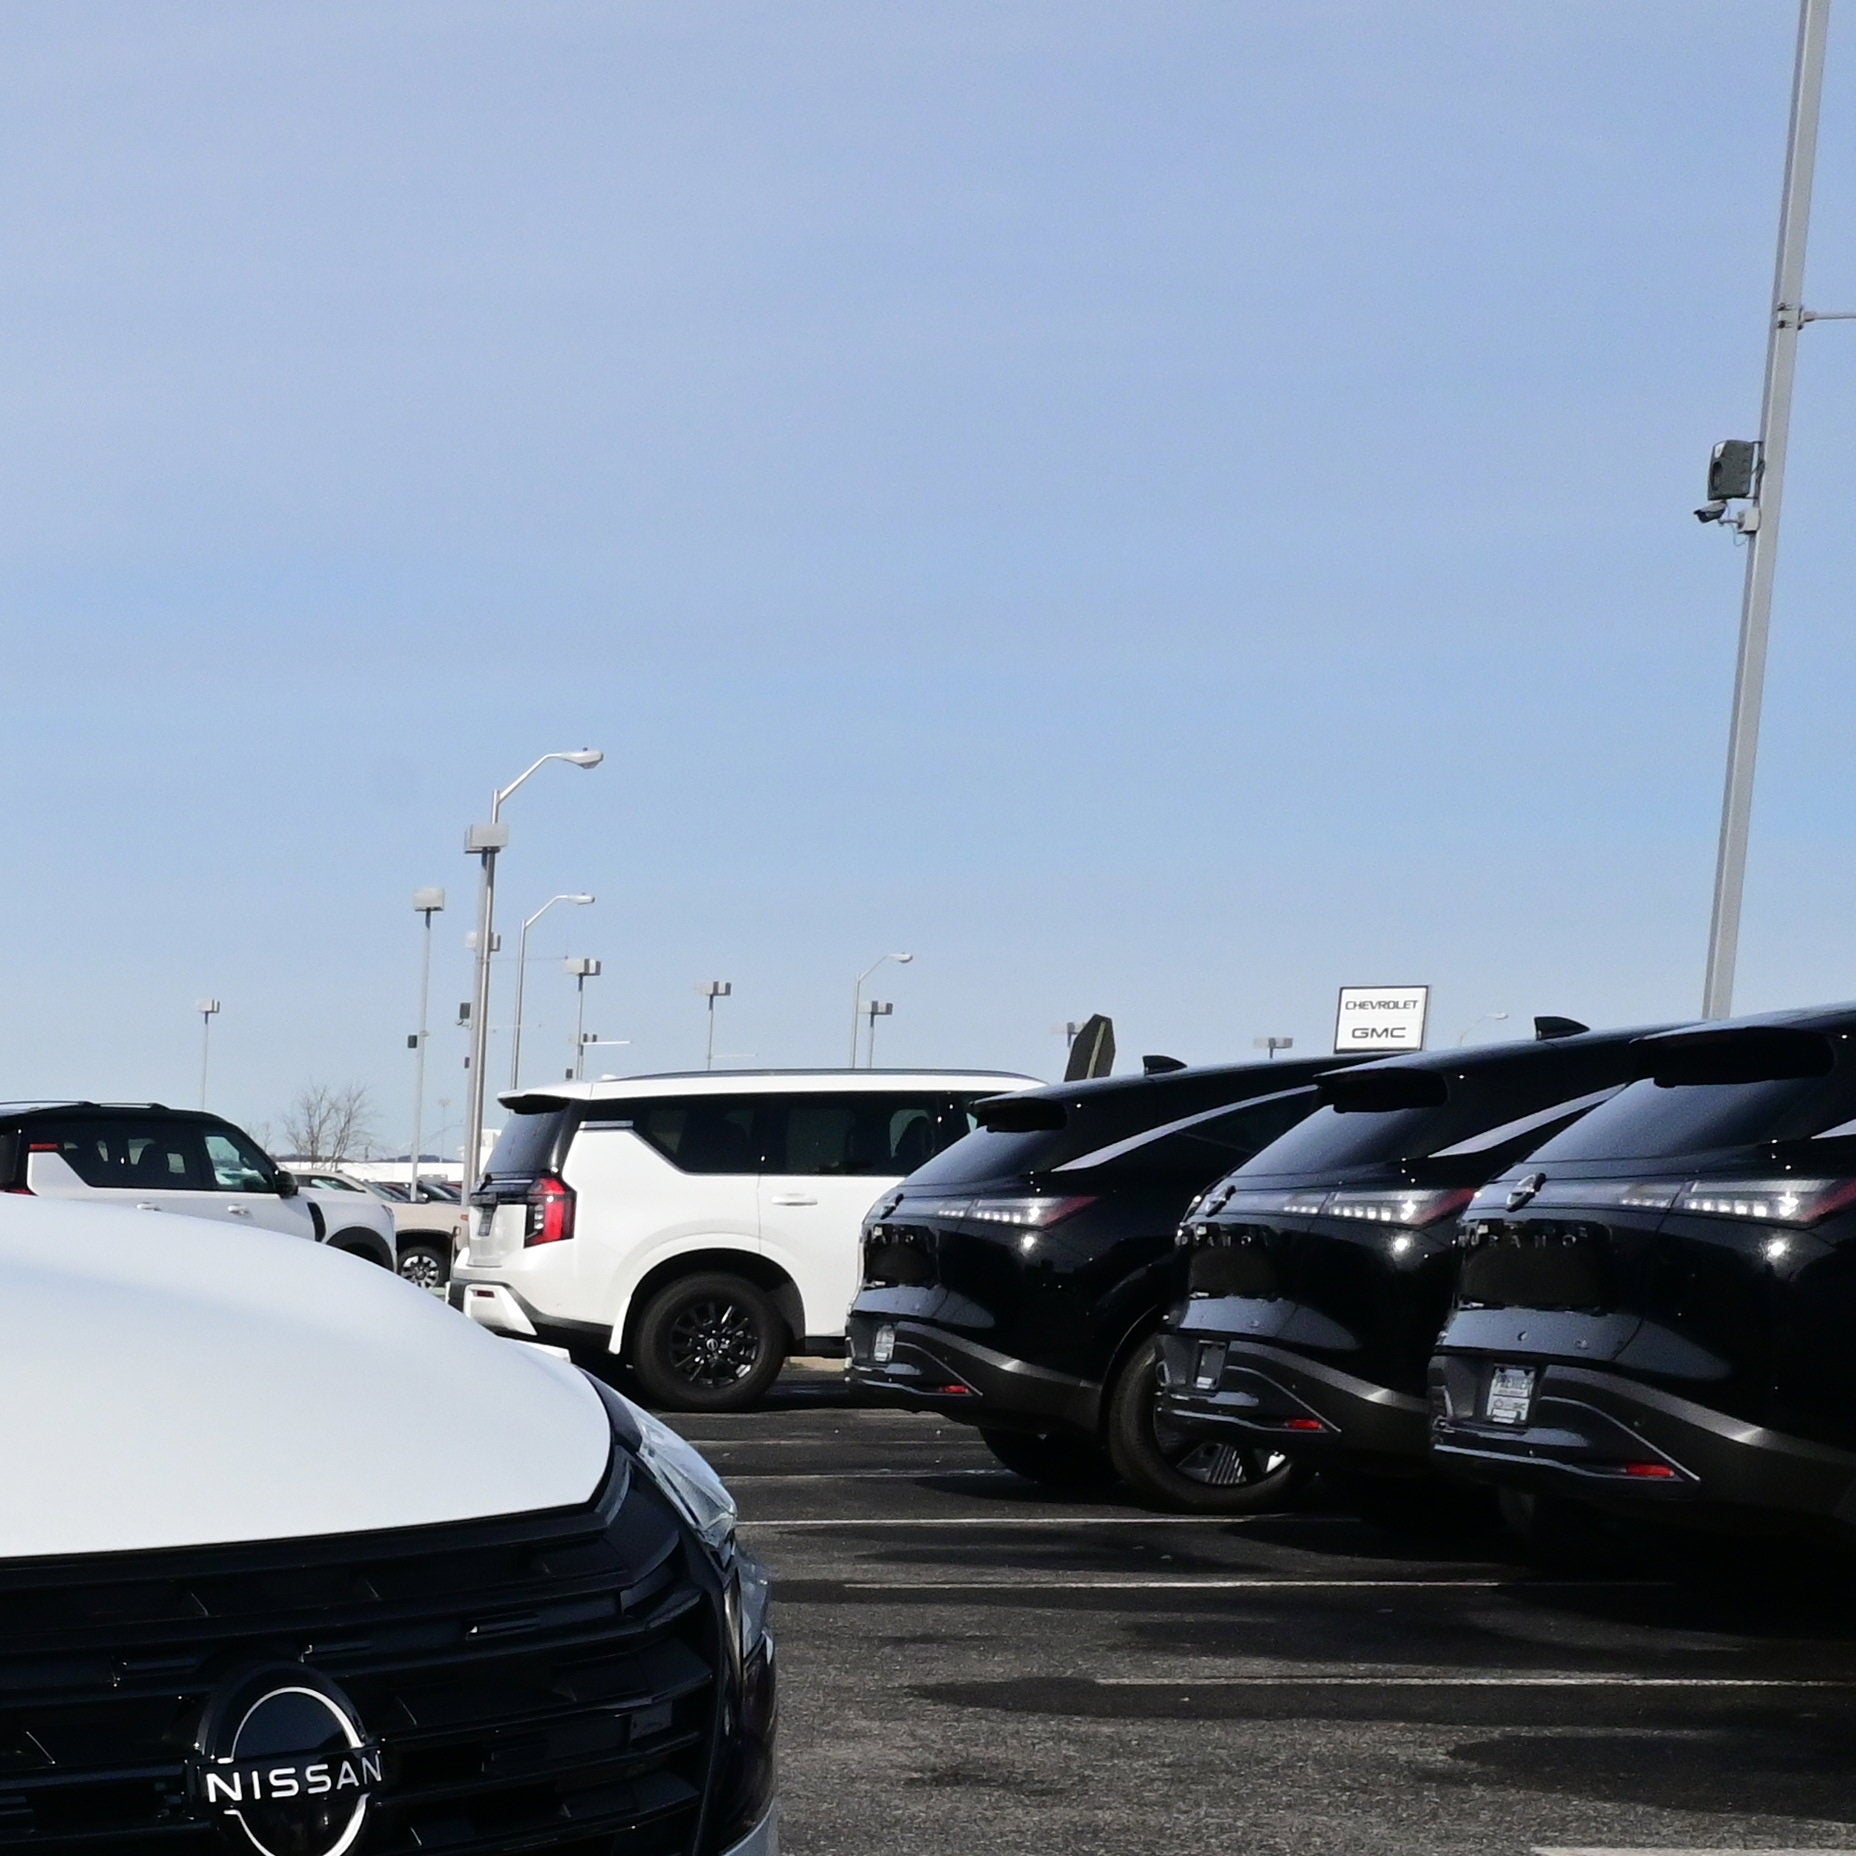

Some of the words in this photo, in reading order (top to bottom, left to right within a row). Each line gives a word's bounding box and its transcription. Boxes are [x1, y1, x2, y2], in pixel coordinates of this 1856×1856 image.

[1345, 1000, 1418, 1010] CHEVROLET
[1352, 1027, 1406, 1039] GMC
[205, 1750, 383, 1804] NISSAN
